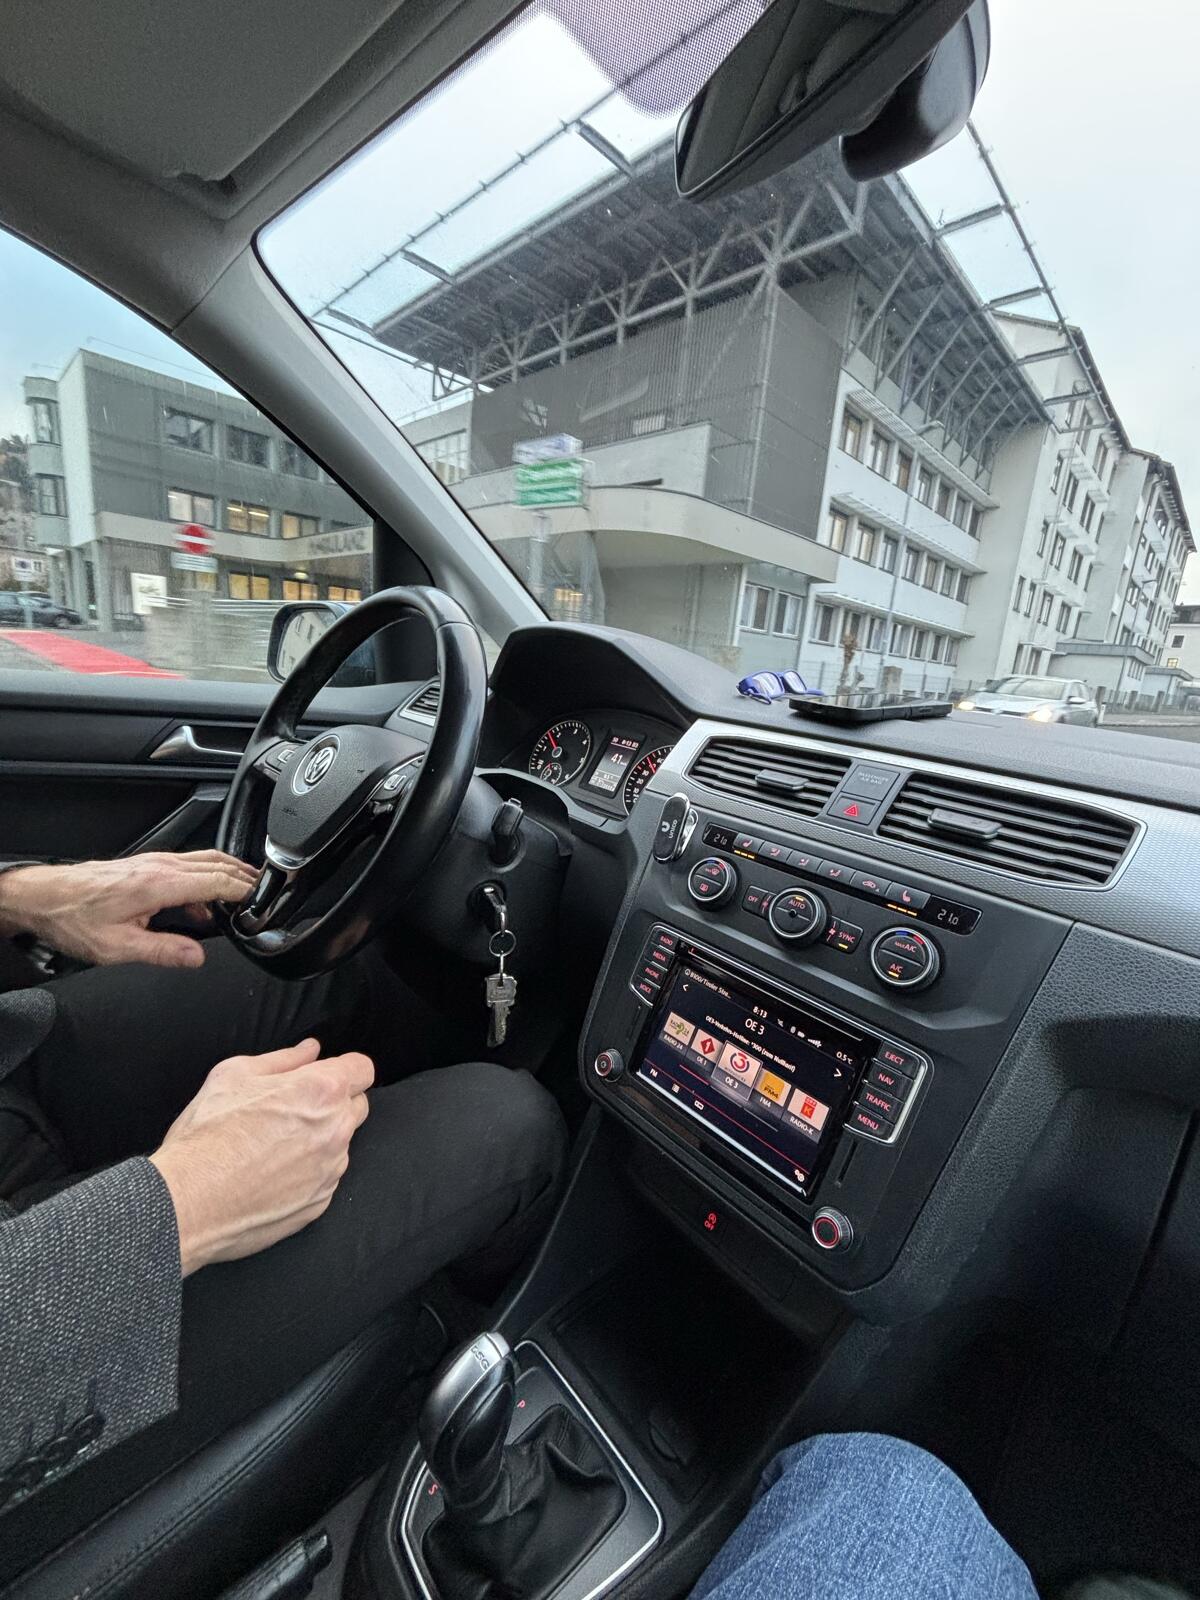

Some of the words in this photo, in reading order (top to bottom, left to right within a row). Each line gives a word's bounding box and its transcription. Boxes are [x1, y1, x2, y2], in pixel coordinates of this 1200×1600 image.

[611, 753, 623, 765] 41
[748, 895, 758, 903] OFF
[788, 899, 806, 910] AUTO
[937, 908, 959, 926] 21.0
[838, 931, 856, 944] SYNC
[889, 963, 903, 973] A/C
[752, 1005, 768, 1018] 8:13
[744, 1018, 758, 1032] OE
[758, 1026, 765, 1036] 3
[884, 1051, 905, 1065] EJECT
[878, 1073, 895, 1086] NAV
[865, 1093, 892, 1112] TRAFFIC
[789, 1116, 814, 1135] RADIO-K
[857, 1113, 879, 1130] MENU
[428, 1483, 438, 1495] S
